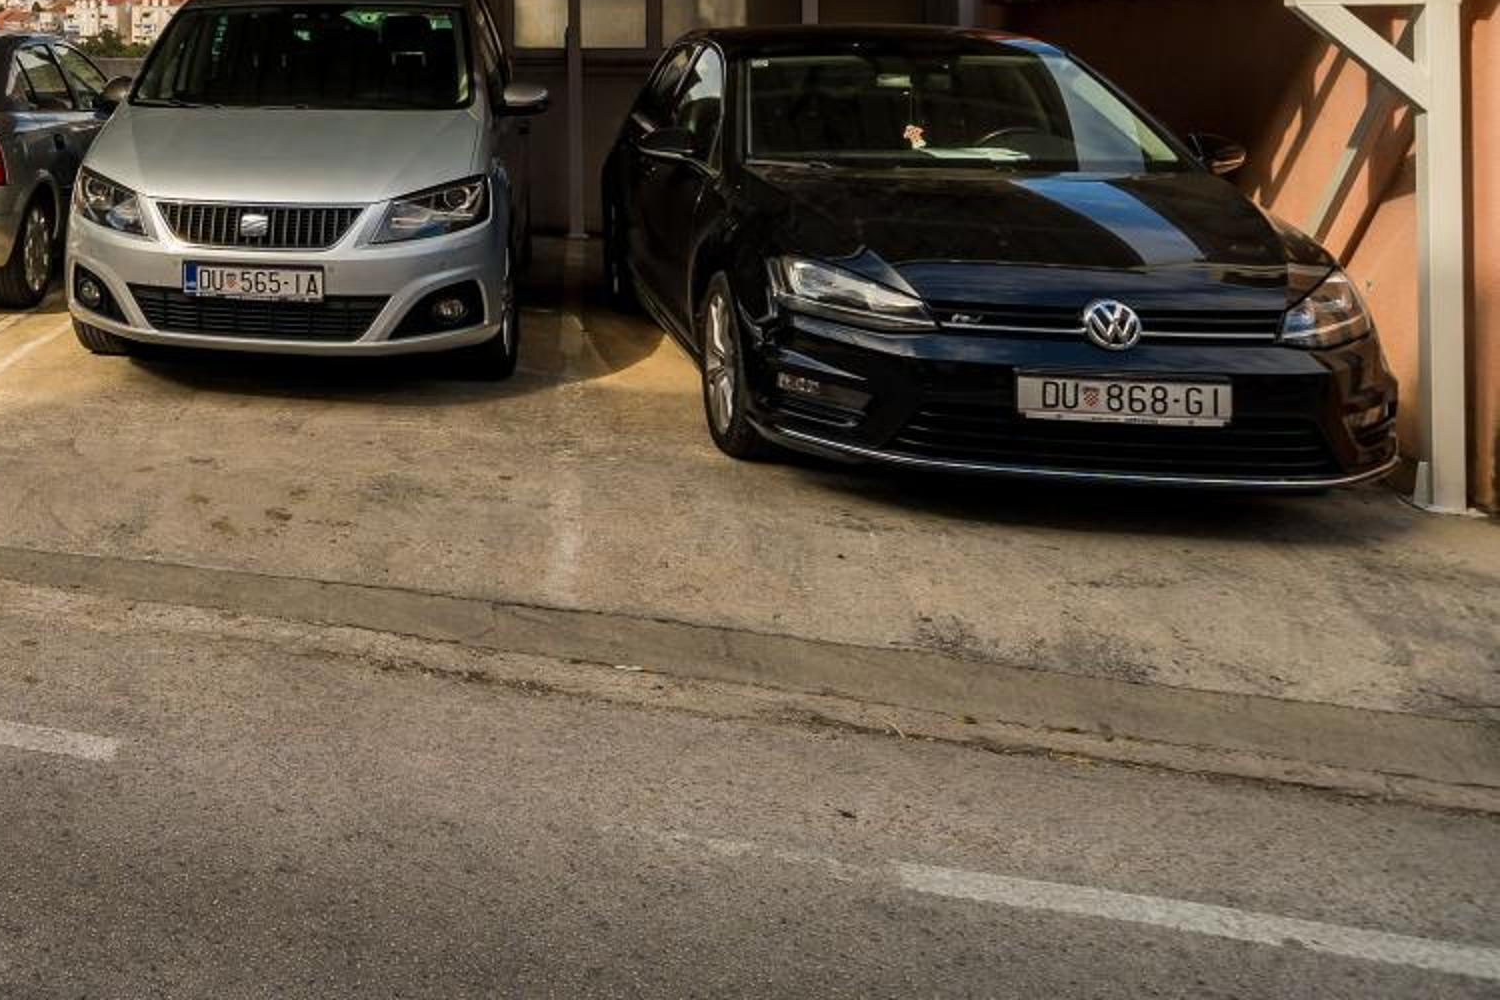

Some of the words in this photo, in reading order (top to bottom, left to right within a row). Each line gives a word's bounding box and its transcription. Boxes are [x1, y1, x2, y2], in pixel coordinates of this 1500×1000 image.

[200, 269, 224, 291] DU
[241, 271, 318, 295] 565-IA
[1042, 381, 1079, 409] DU
[1106, 384, 1219, 417] 868-GI
